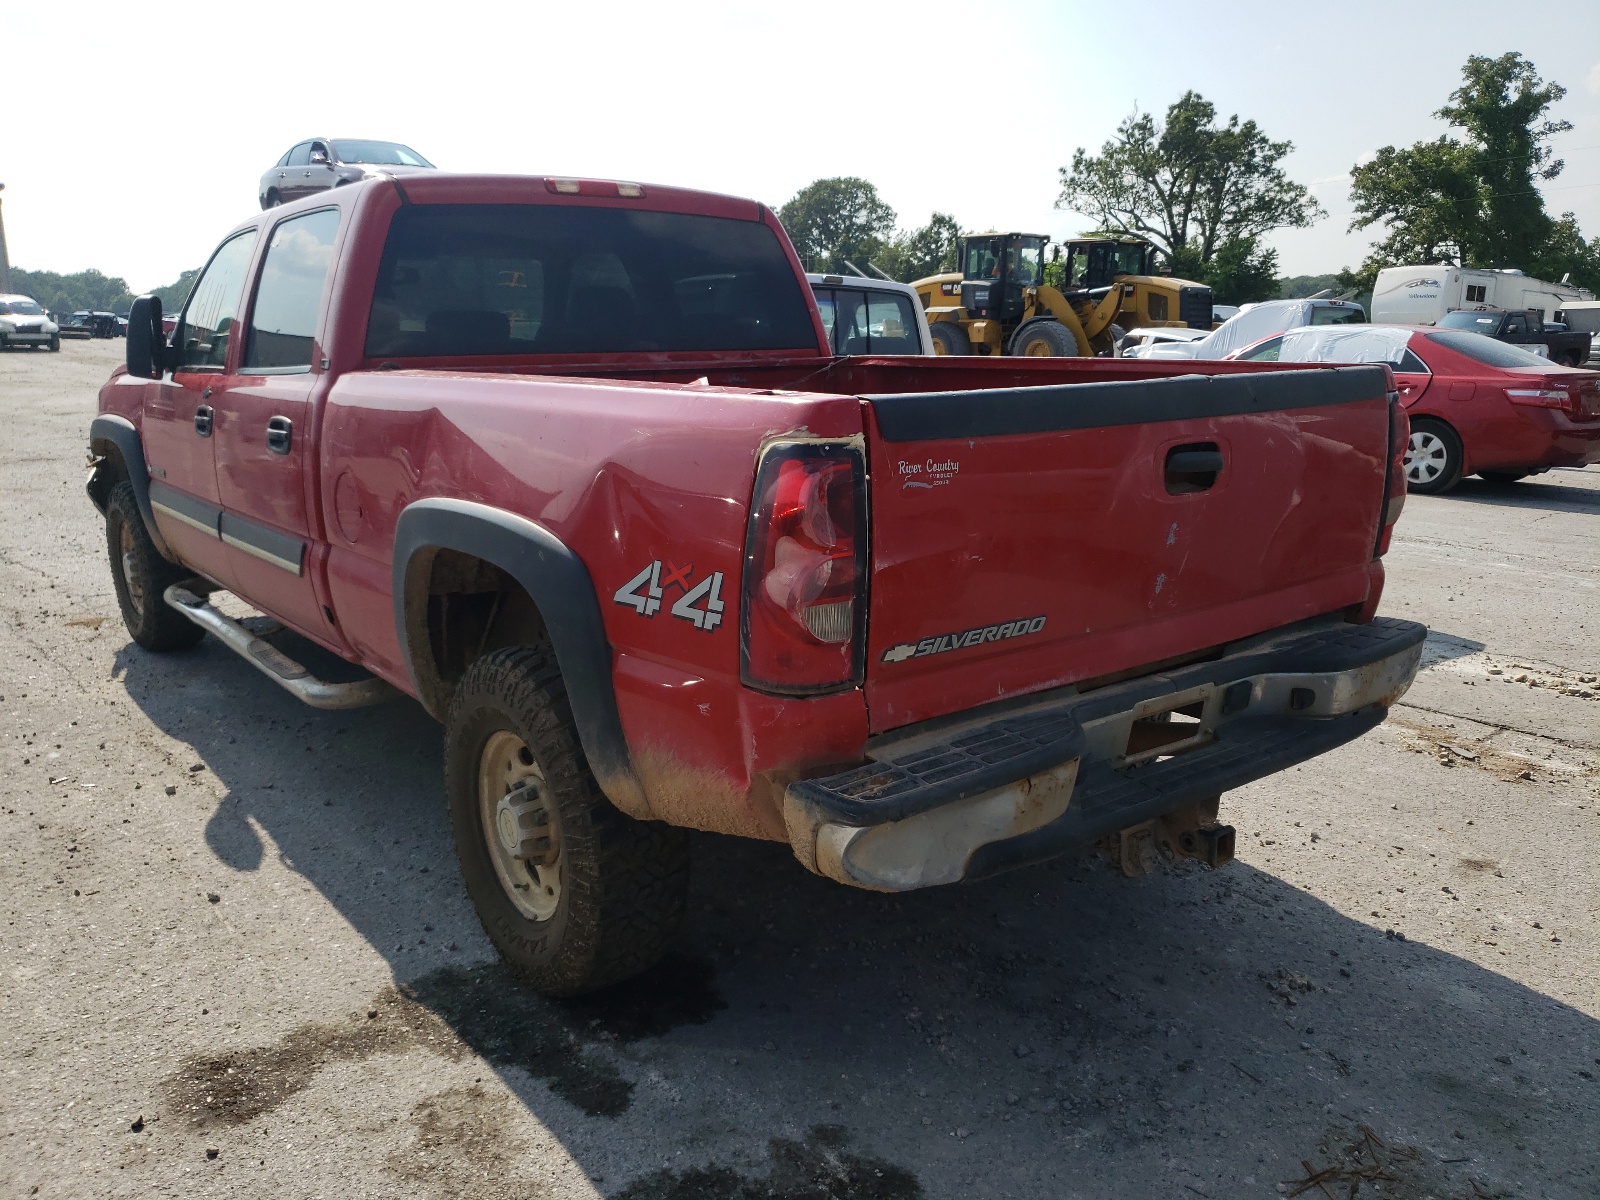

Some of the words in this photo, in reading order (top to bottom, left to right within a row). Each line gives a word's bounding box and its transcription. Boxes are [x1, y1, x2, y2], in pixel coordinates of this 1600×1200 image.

[898, 460, 922, 475] River
[926, 458, 959, 474] Country
[914, 615, 1047, 658] SILVERADO
